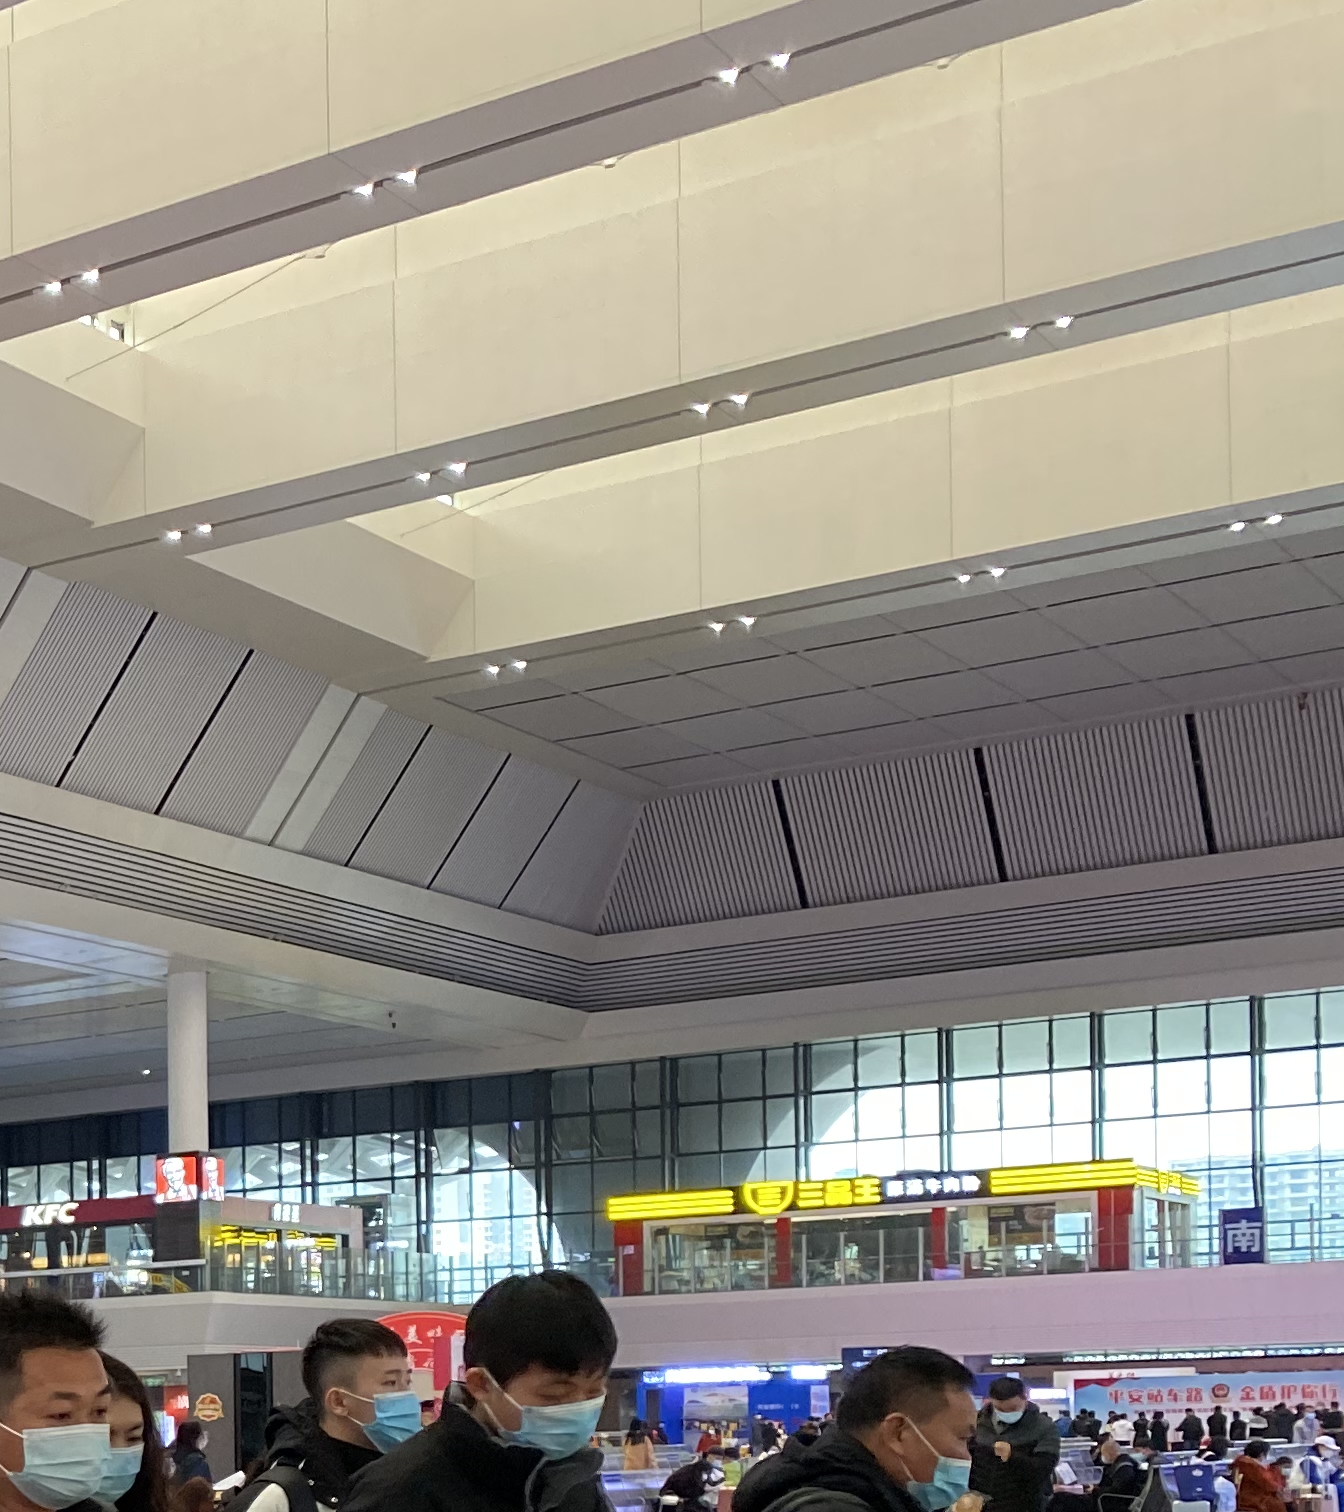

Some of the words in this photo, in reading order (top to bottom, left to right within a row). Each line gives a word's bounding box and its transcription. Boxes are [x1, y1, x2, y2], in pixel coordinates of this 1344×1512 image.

[797, 1177, 882, 1209] 三品王
[21, 1201, 80, 1227] KFC
[1225, 1218, 1263, 1254] 南
